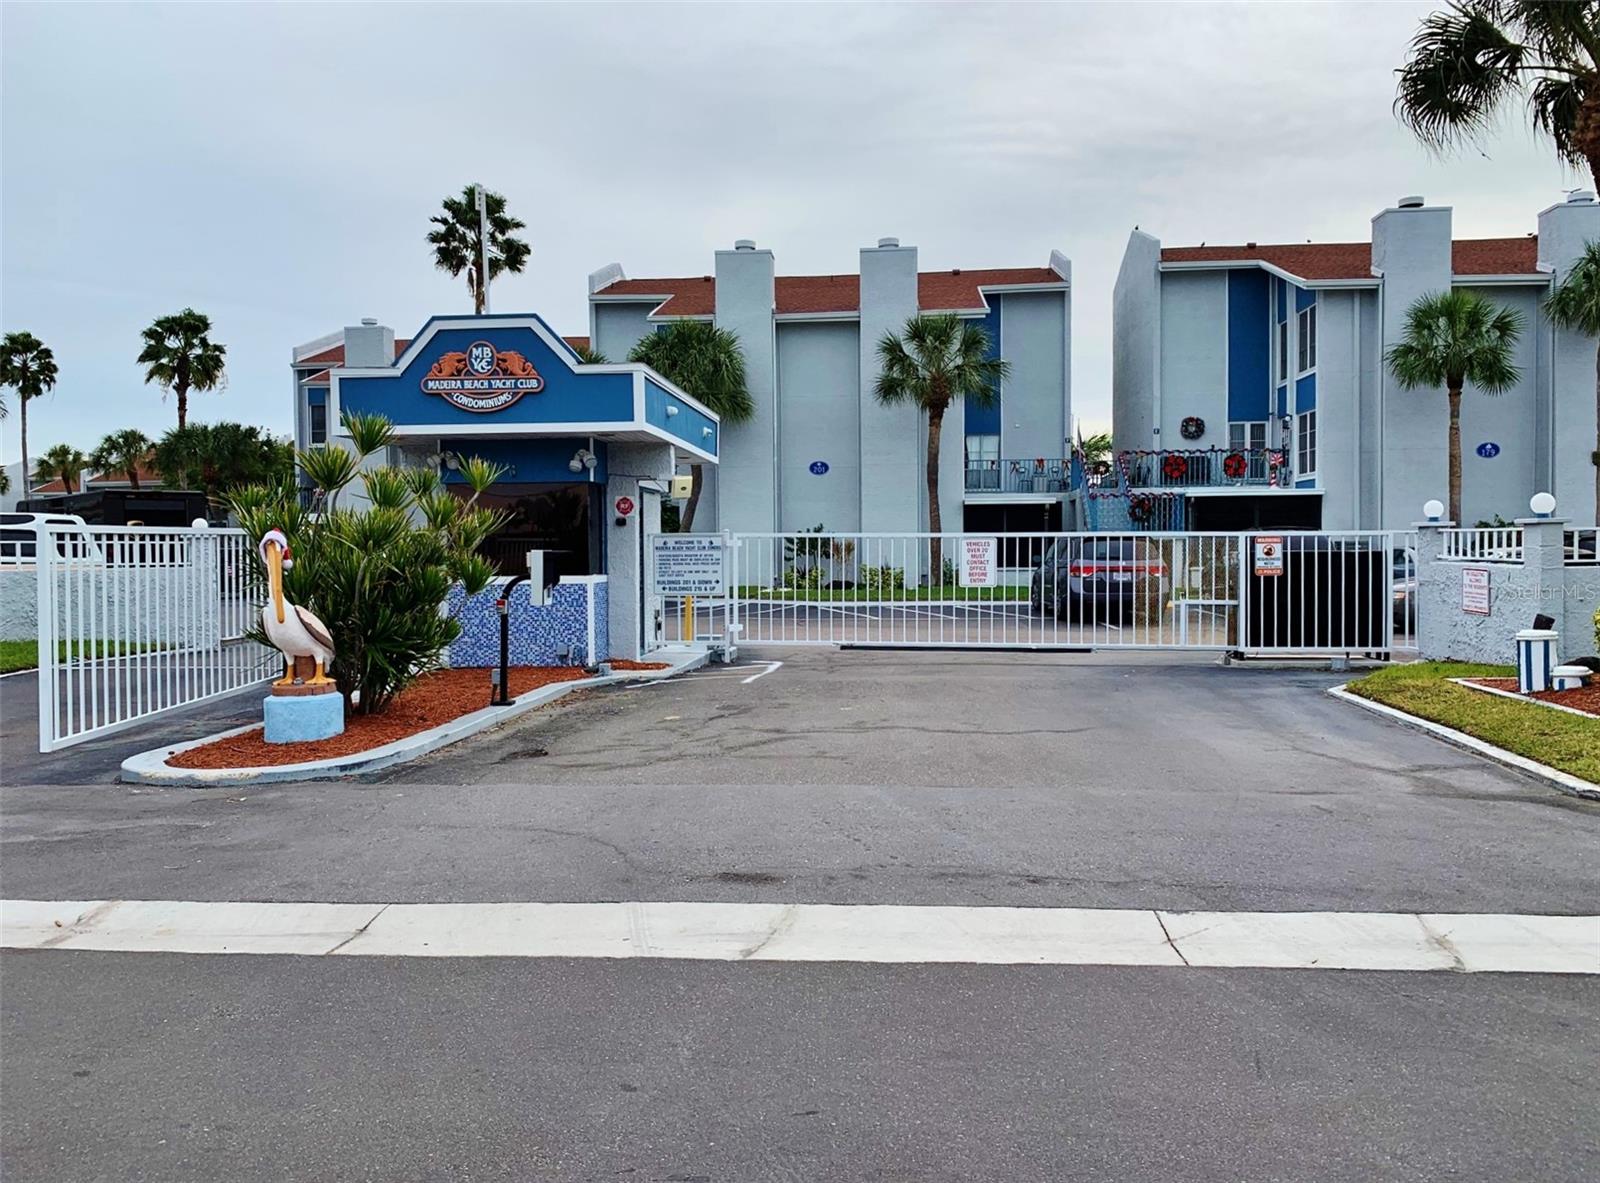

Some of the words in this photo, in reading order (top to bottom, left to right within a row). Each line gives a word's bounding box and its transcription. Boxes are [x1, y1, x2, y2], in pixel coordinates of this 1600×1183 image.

[428, 380, 462, 390] MADEIRA
[464, 380, 489, 389] BEACH
[491, 380, 515, 389] YACHT
[517, 379, 538, 388] CLUB
[452, 392, 513, 408] CONDOMINIUMS
